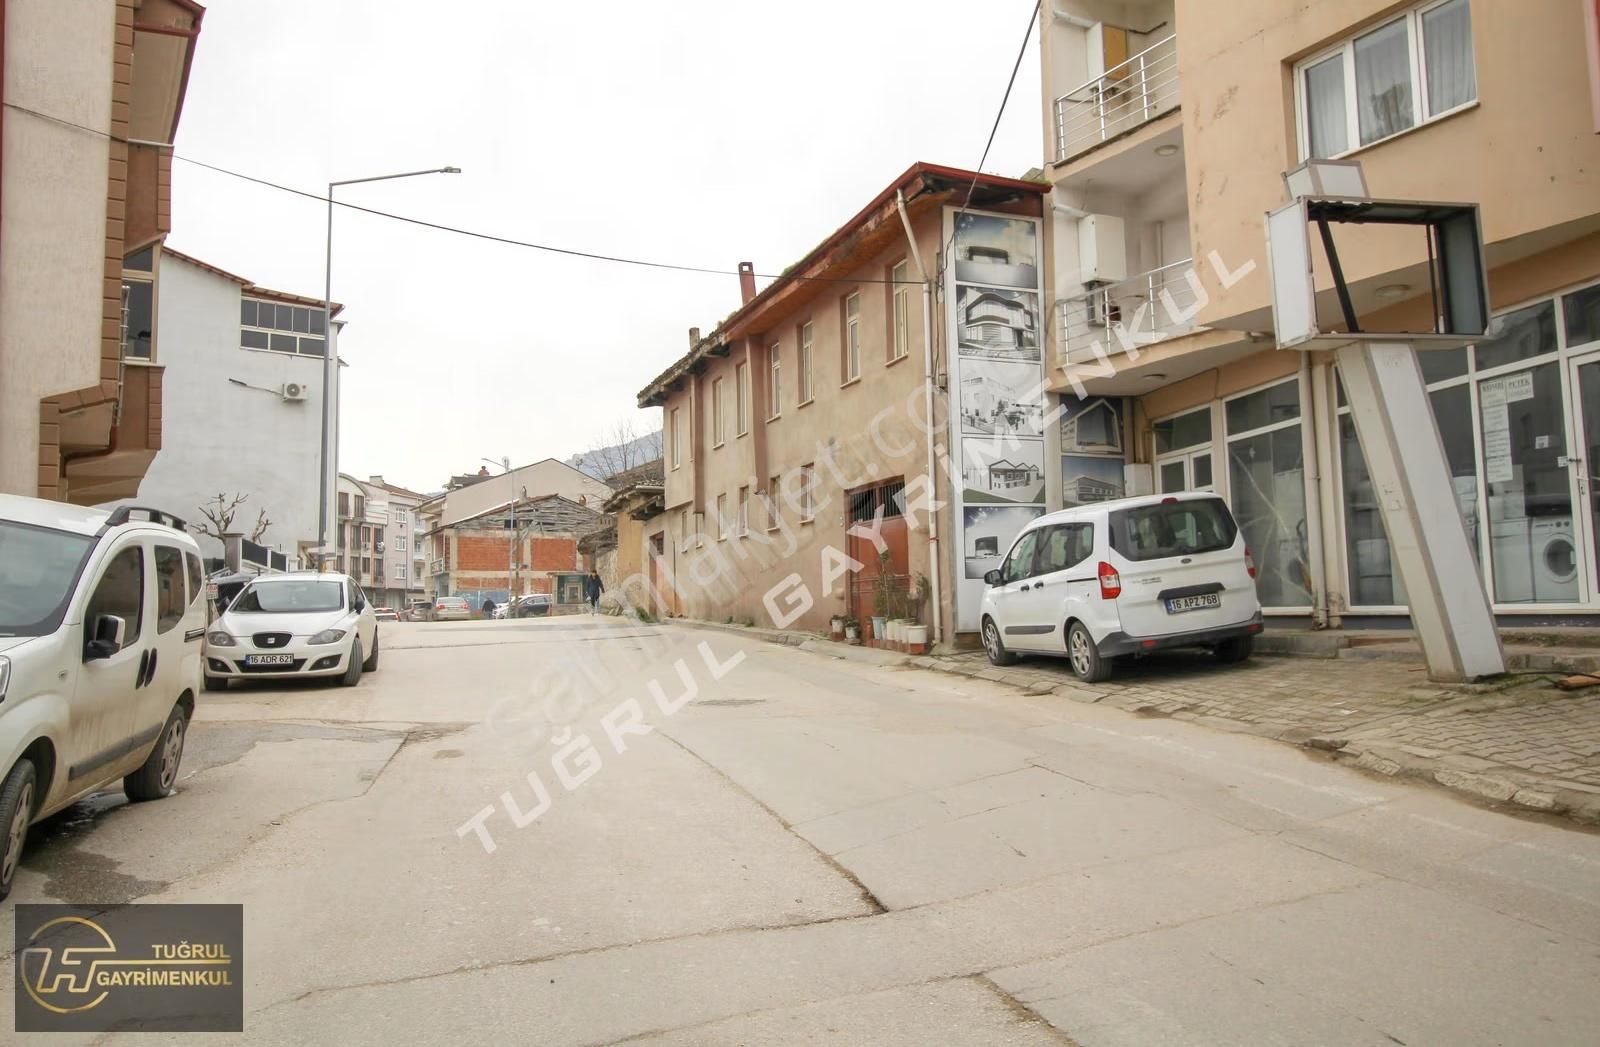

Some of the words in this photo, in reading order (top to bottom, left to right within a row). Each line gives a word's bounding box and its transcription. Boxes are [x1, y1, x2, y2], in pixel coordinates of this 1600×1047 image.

[1172, 600, 1182, 610] 16
[1184, 597, 1200, 607] APZ
[1201, 594, 1217, 605] 768
[250, 655, 259, 663] 16
[260, 655, 277, 663] ADR
[279, 655, 292, 663] 621
